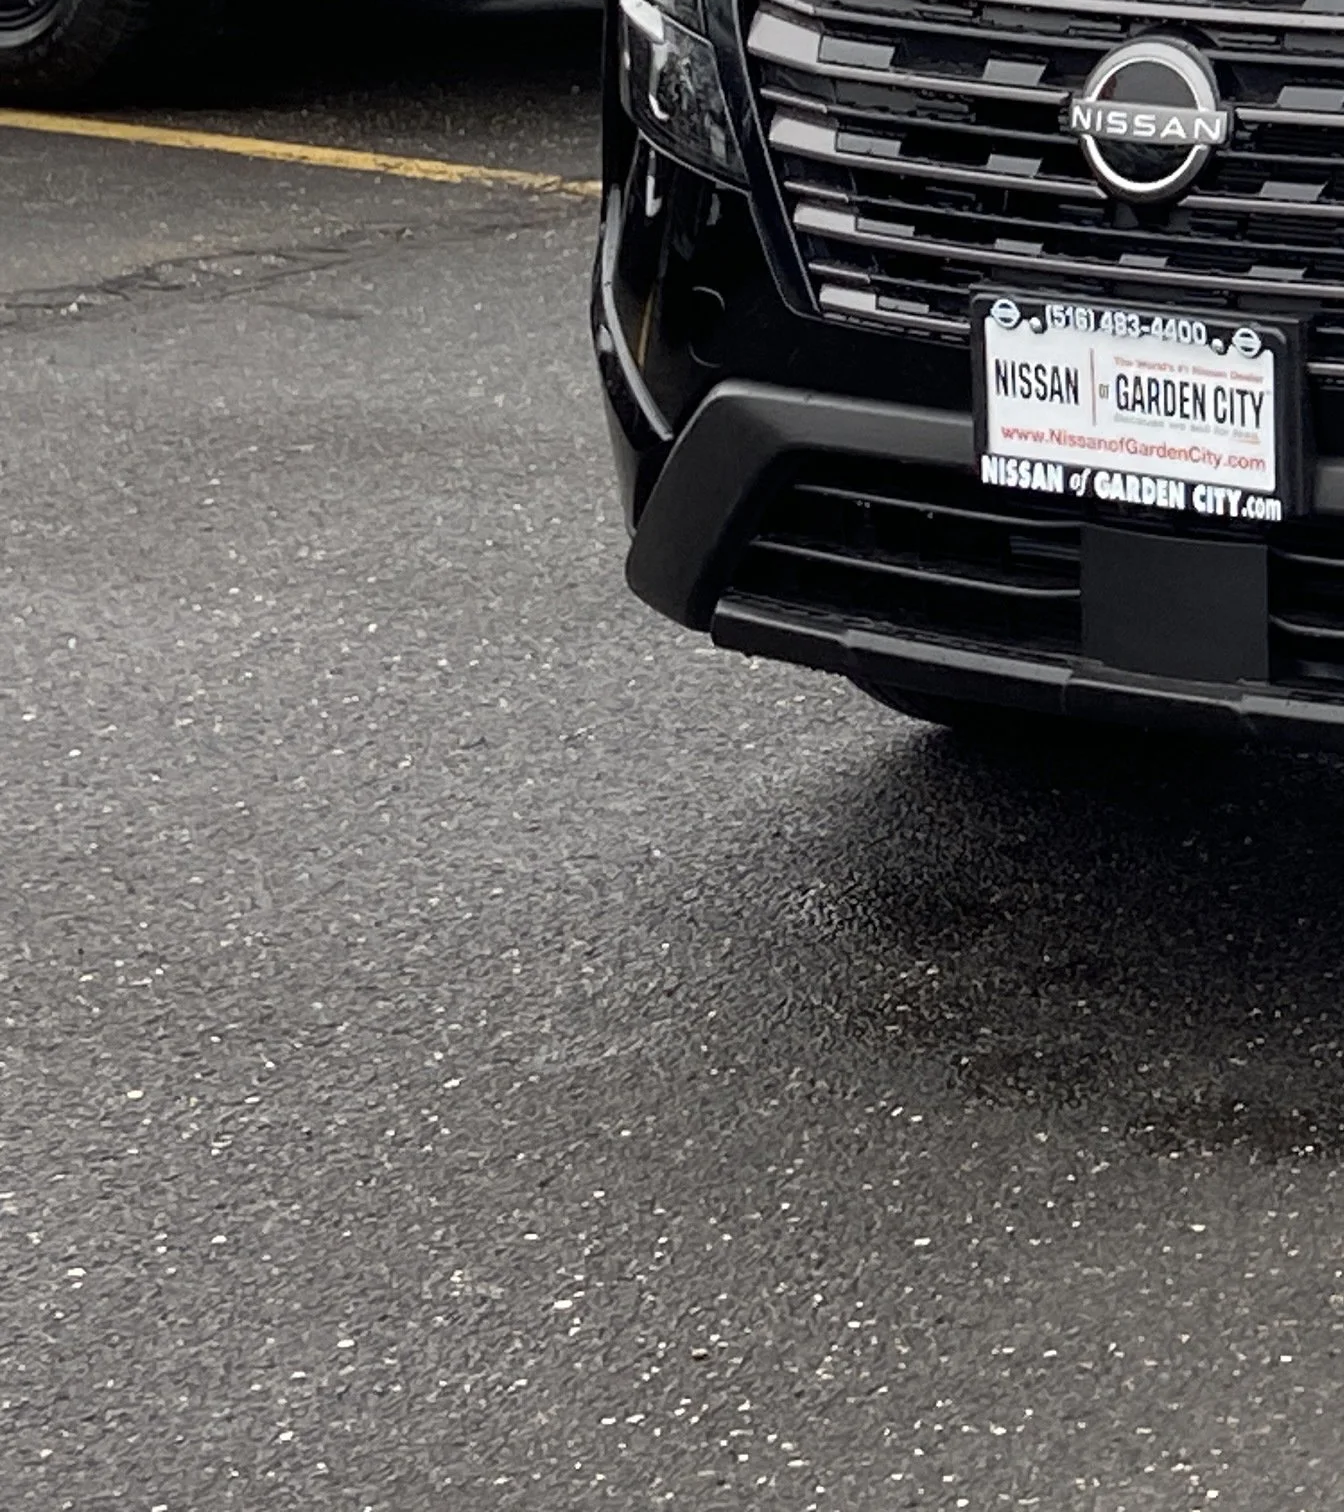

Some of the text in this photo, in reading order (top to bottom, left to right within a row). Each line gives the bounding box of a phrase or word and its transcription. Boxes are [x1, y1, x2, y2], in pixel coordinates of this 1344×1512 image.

[1071, 105, 1221, 141] NISSAN
[1046, 304, 1208, 345] (516) 483-4400
[995, 359, 1080, 405] NISSAN
[1116, 373, 1207, 422] GARDEN
[1213, 386, 1265, 429] CITY
[1001, 425, 1266, 472] www.NissanofGardenCity.com
[981, 455, 1282, 521] NISSAN of GARDEN CITY.com
